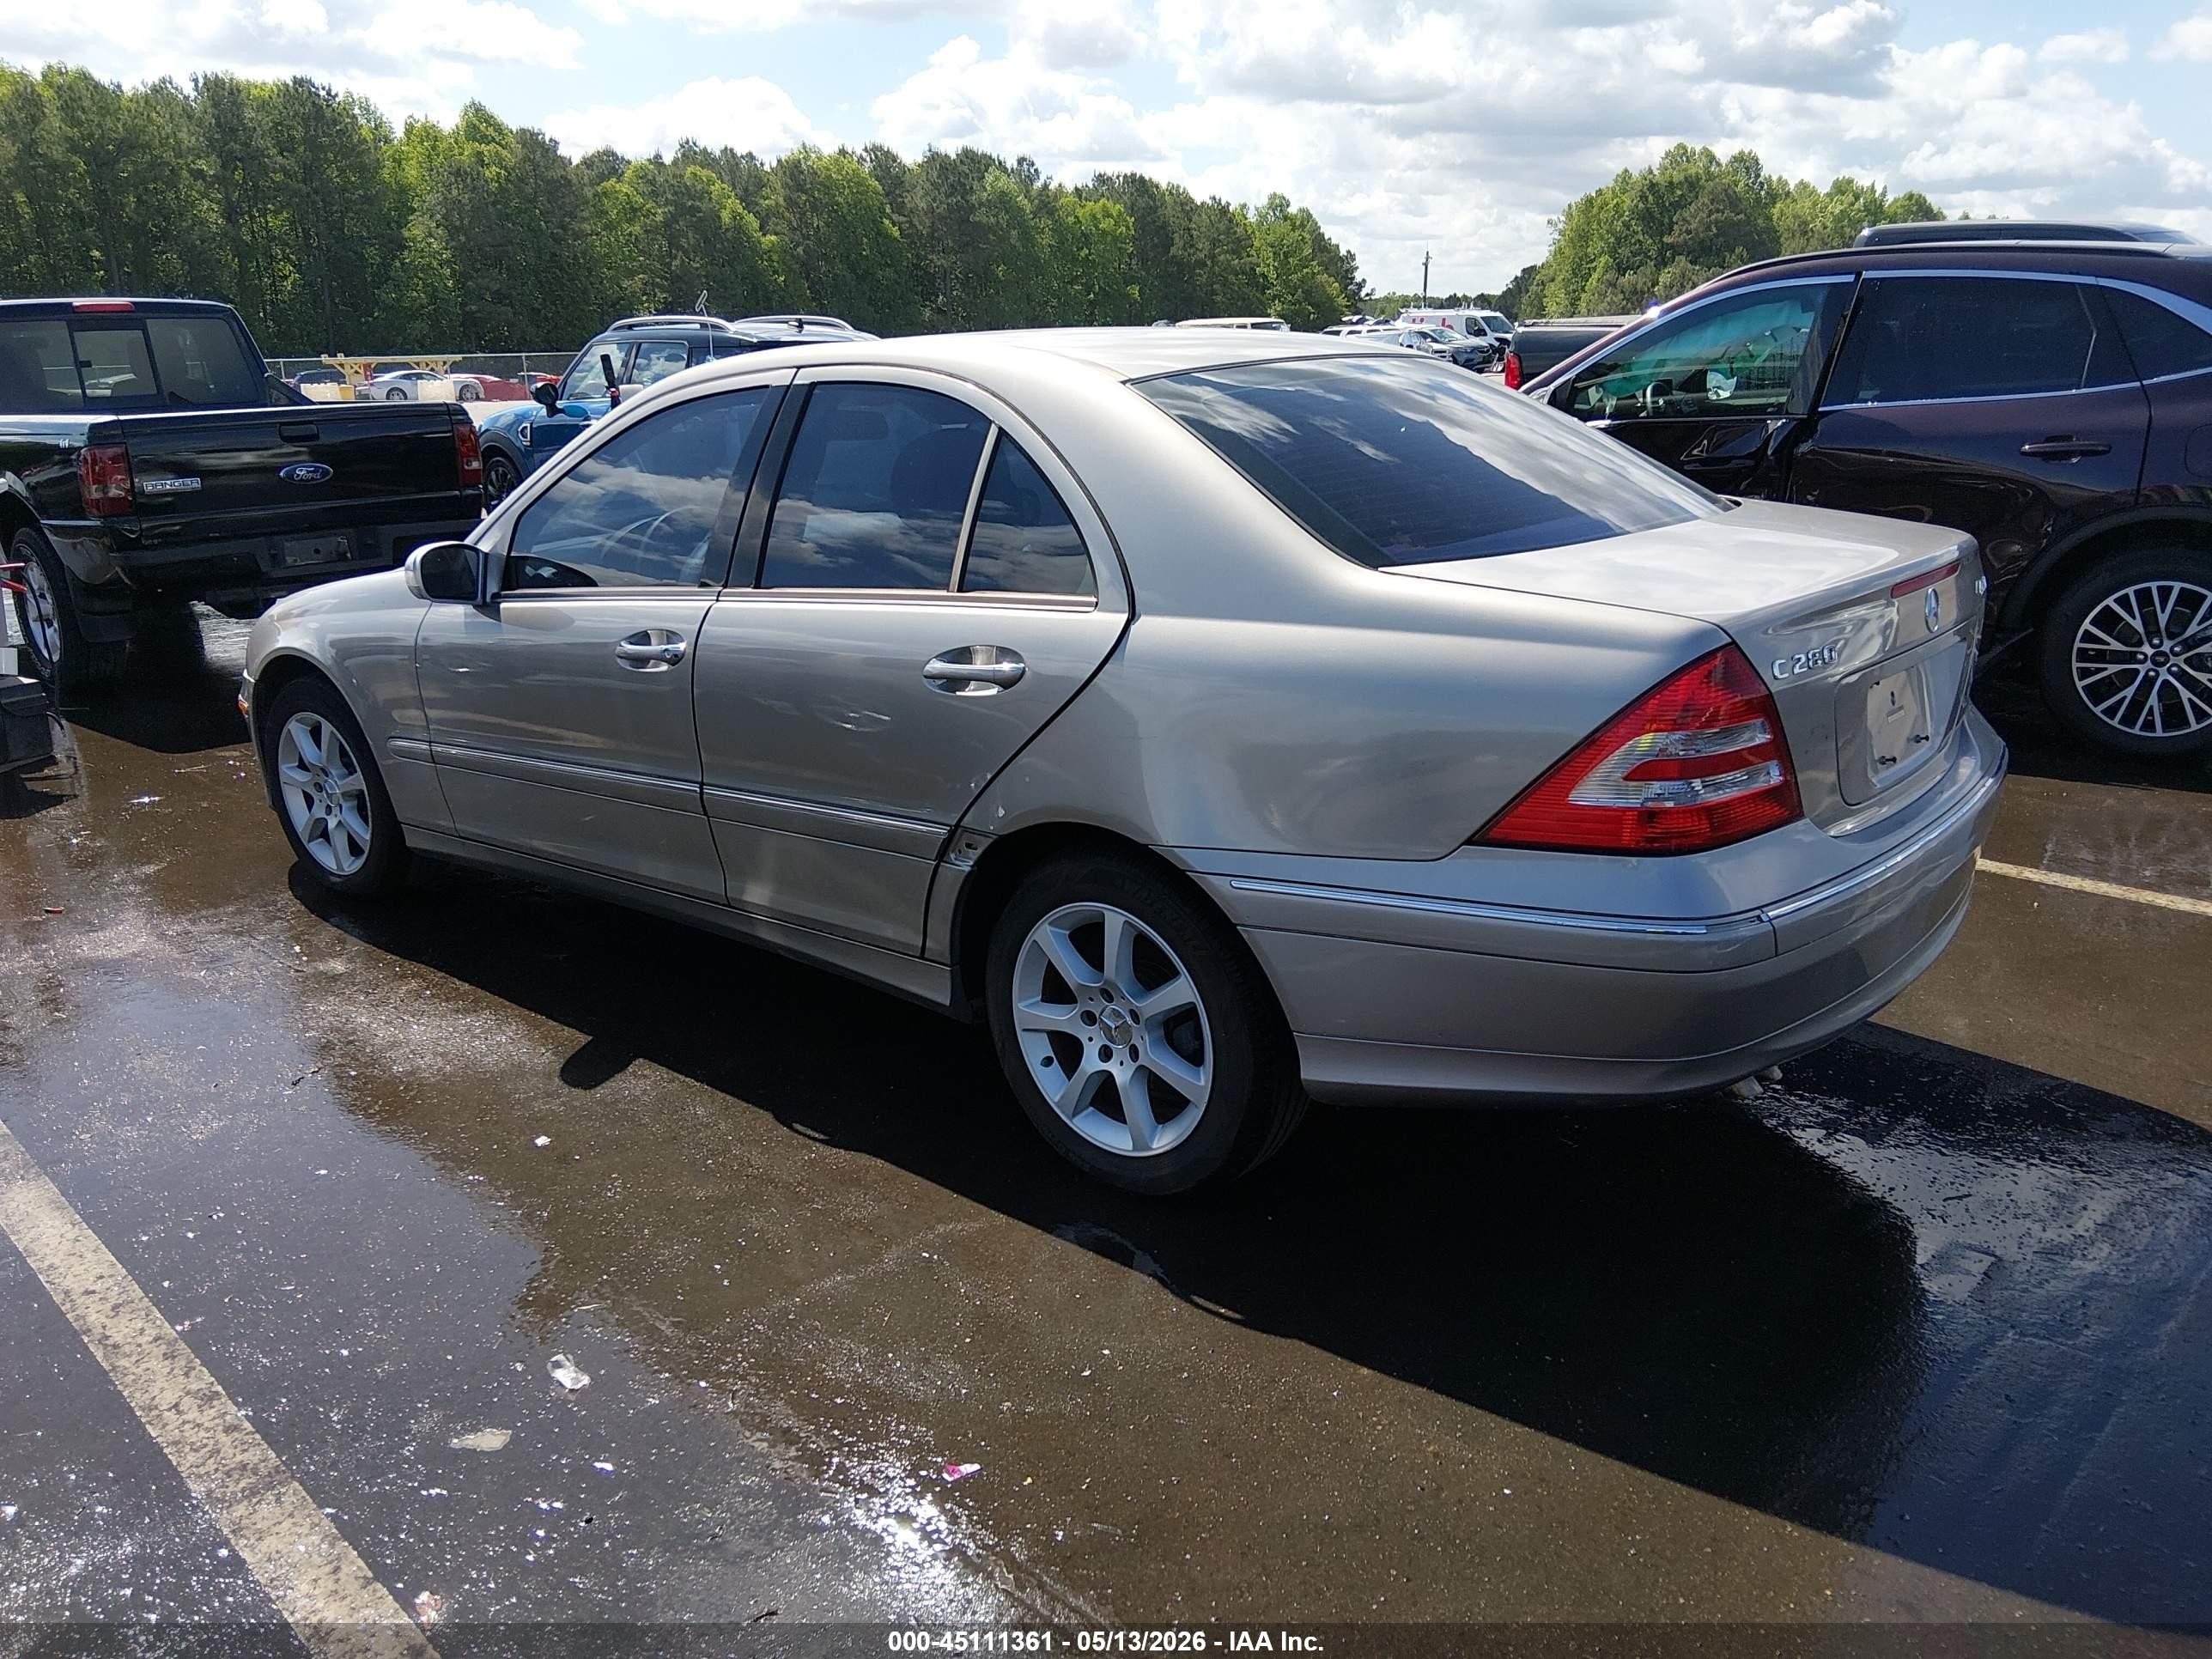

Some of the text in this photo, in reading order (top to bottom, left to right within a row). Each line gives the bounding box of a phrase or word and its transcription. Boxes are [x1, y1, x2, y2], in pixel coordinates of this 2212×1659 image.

[294, 467, 323, 480] Ford
[144, 479, 200, 491] RANGER
[1771, 645, 1838, 680] C 280
